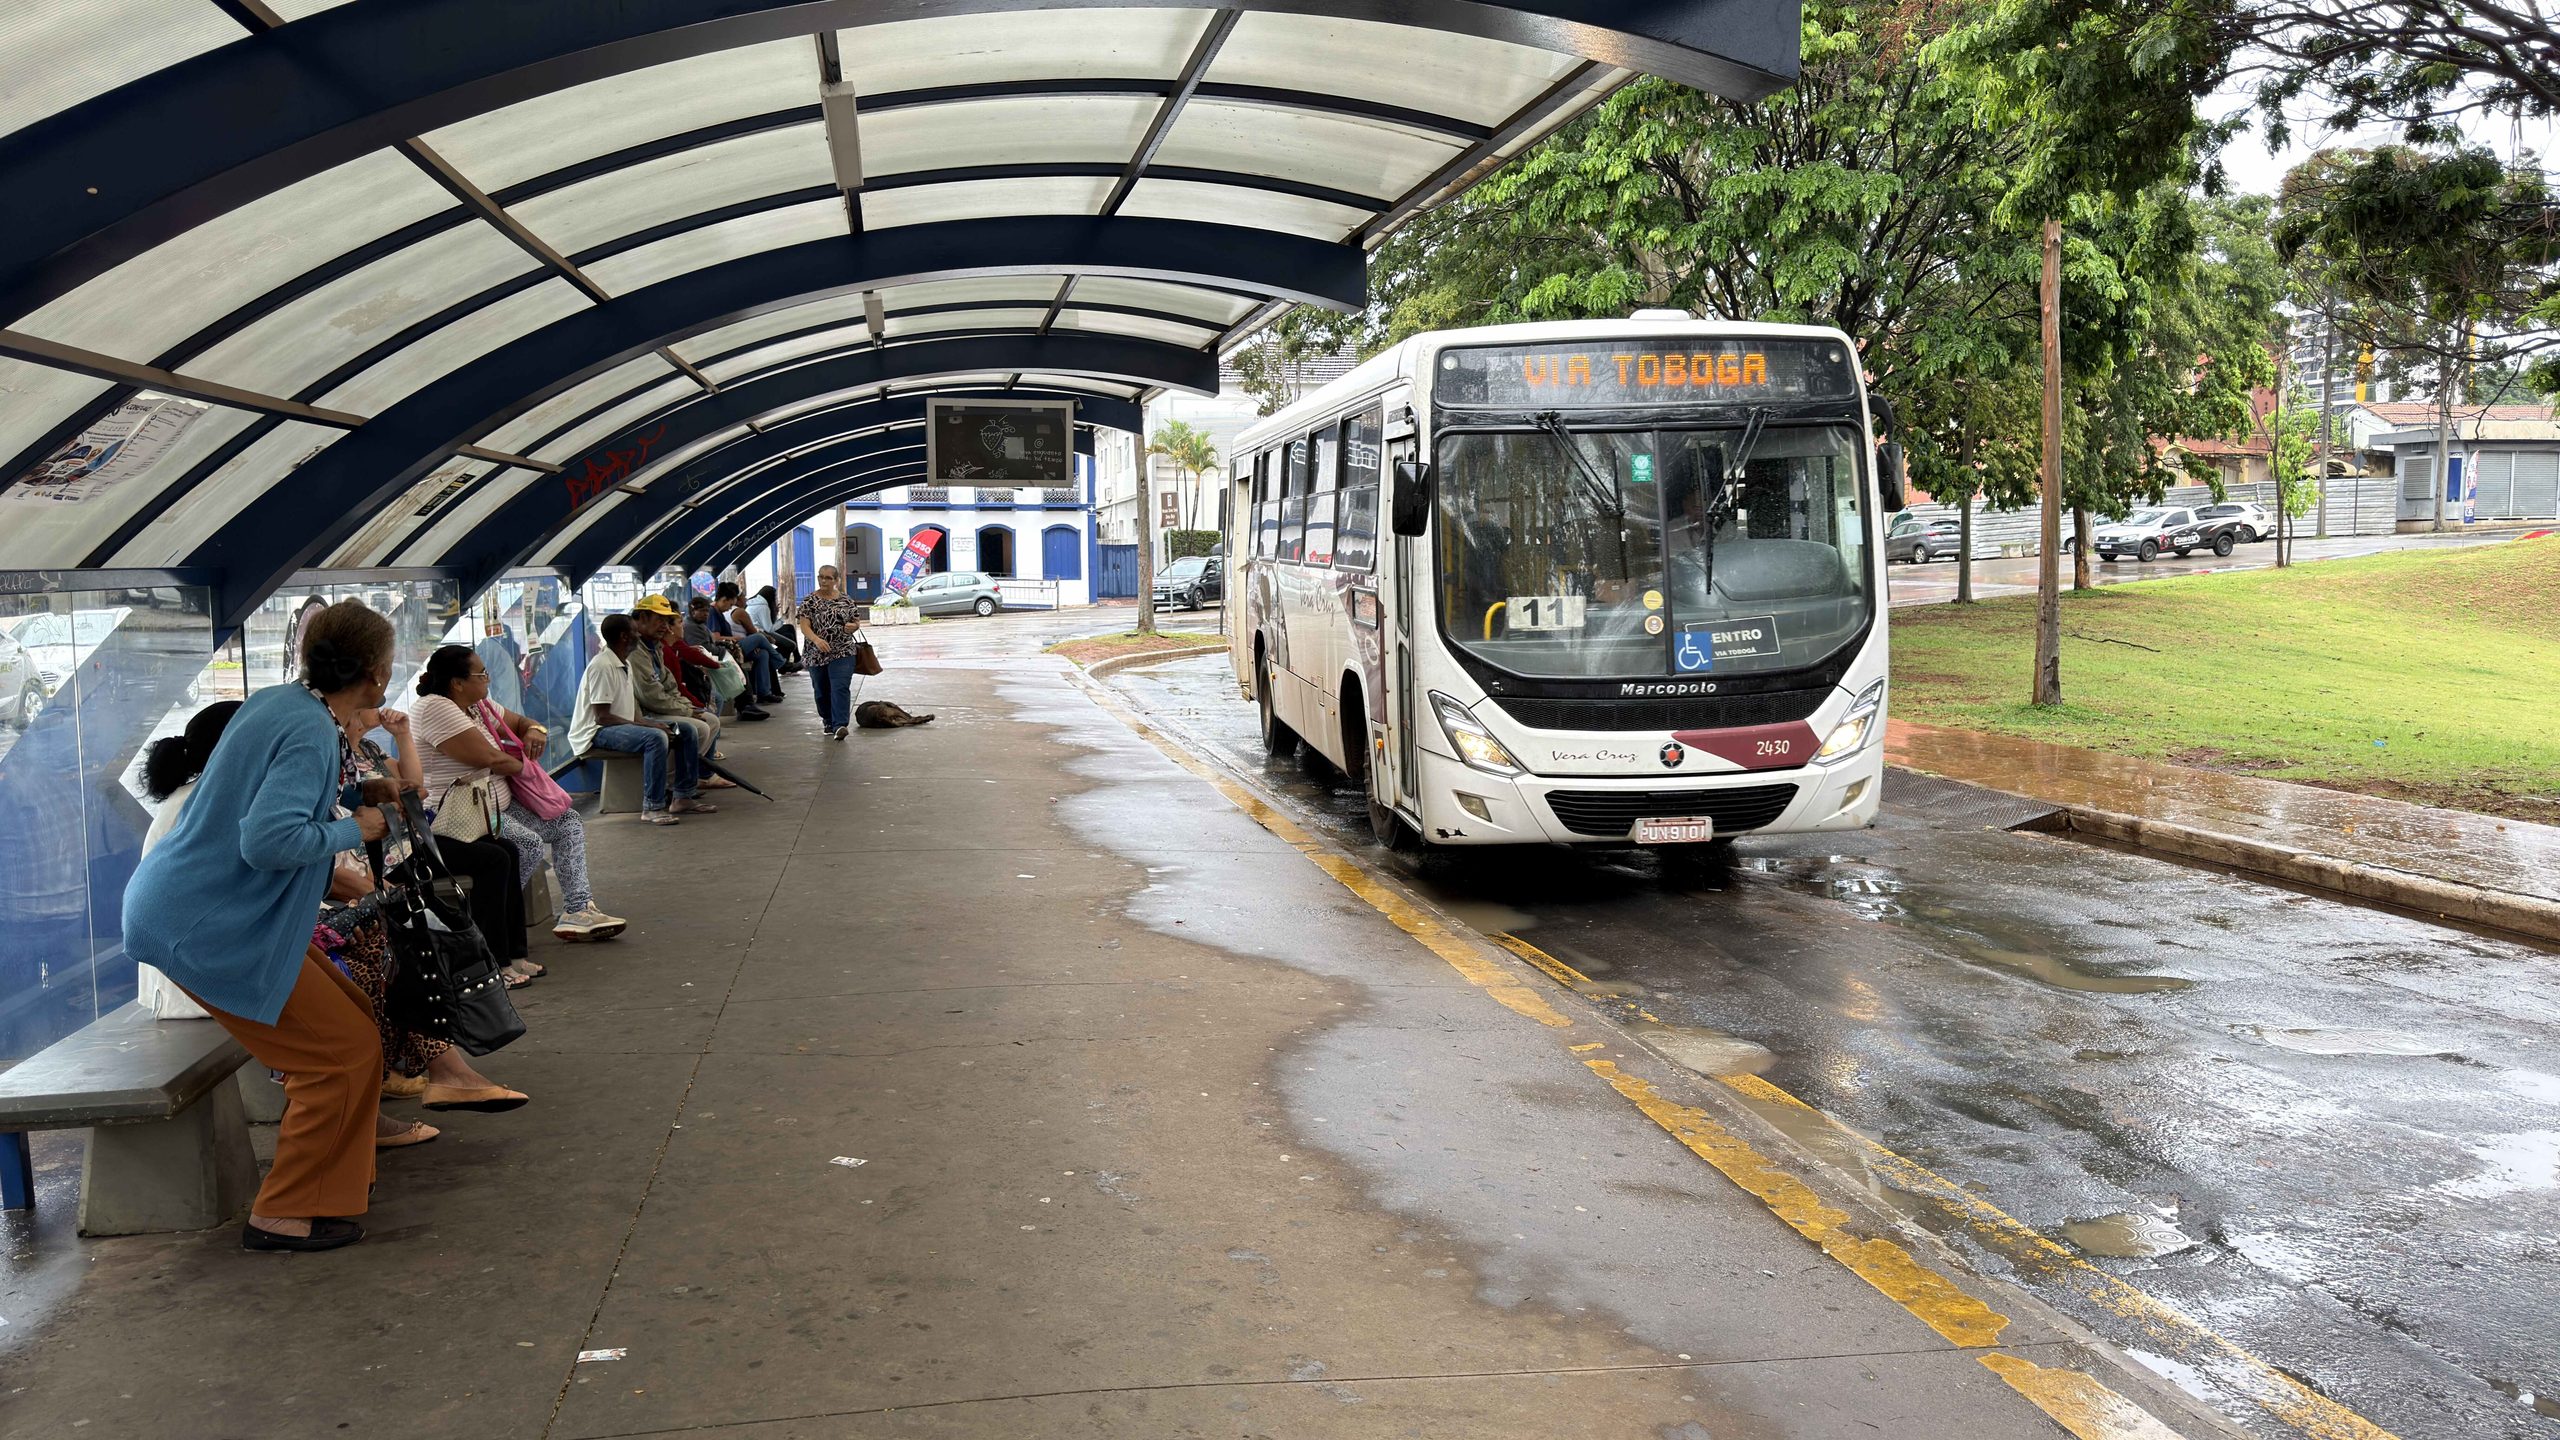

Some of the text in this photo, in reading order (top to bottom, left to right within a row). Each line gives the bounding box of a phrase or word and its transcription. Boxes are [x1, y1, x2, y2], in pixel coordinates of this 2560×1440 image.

[1523, 352, 1767, 386] VIA TOBOGA
[1522, 598, 1565, 627] 11
[1711, 628, 1763, 644] ENTRO
[1714, 649, 1728, 657] VIA
[1619, 681, 1718, 697] Marcopolo
[1756, 739, 1790, 756] 2430
[1552, 749, 1639, 763] Vera Cruz
